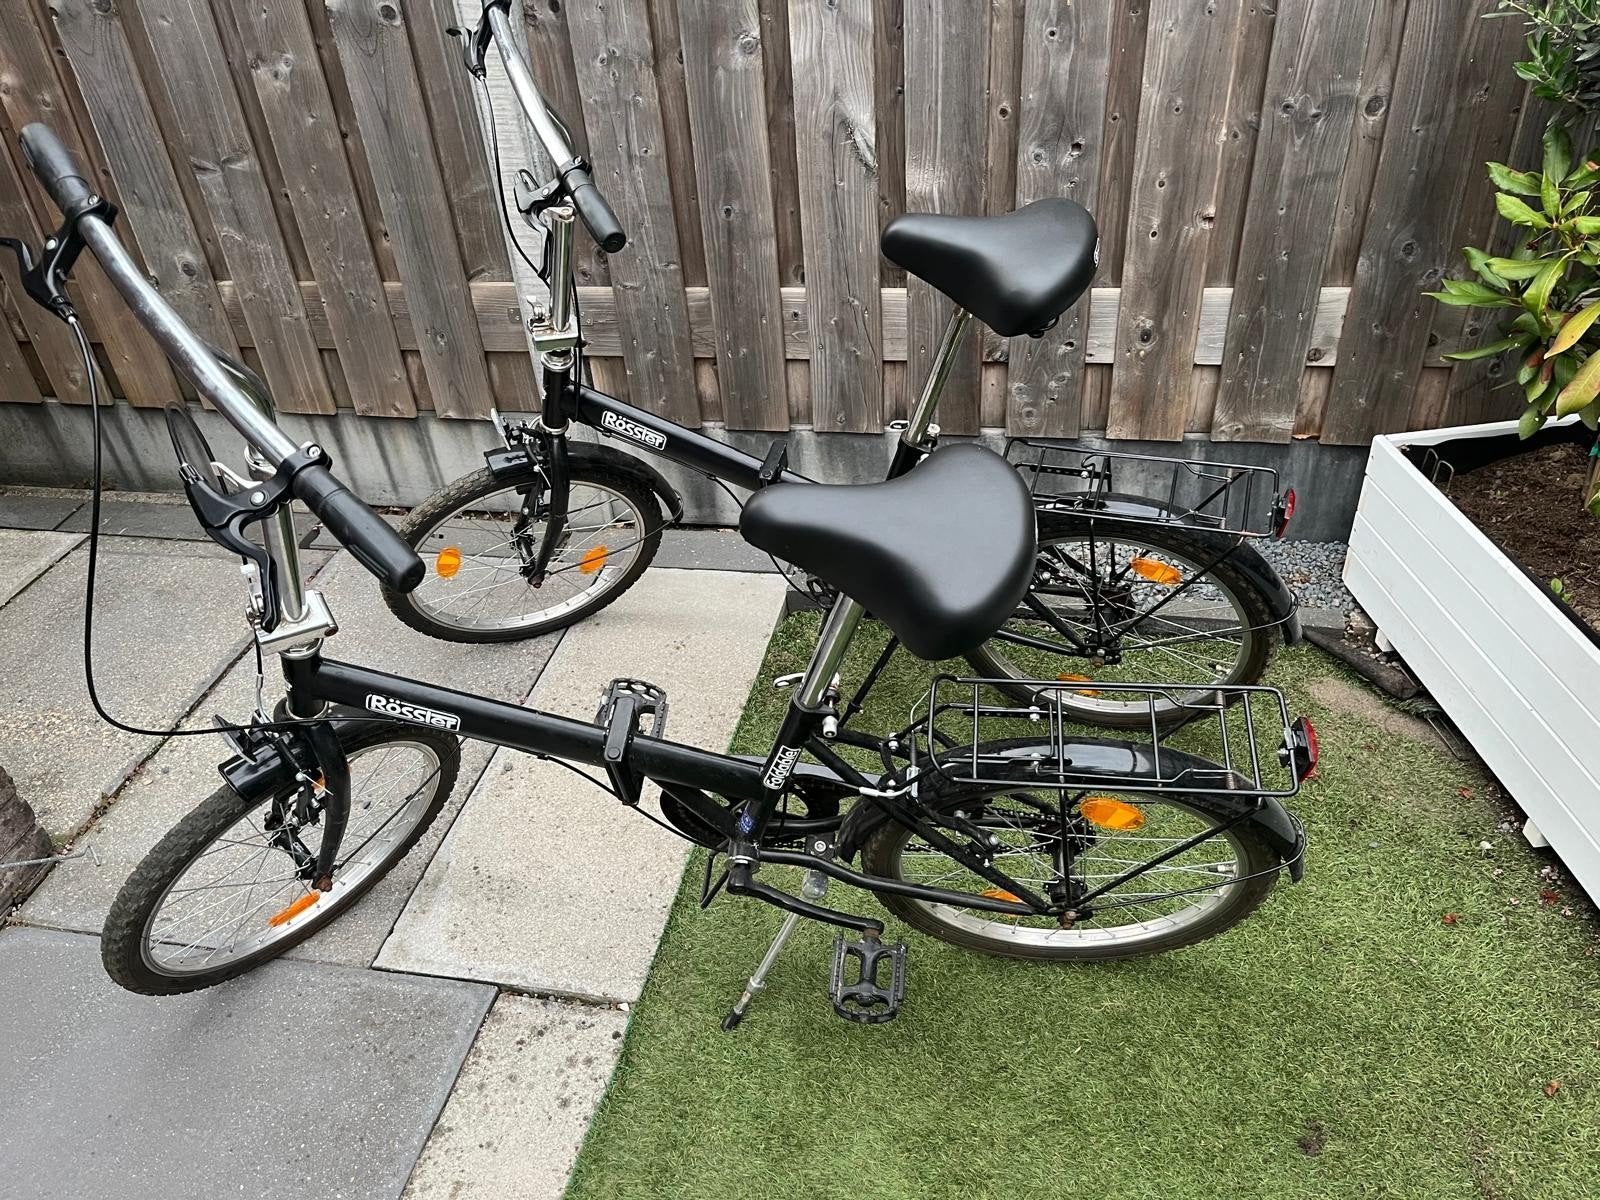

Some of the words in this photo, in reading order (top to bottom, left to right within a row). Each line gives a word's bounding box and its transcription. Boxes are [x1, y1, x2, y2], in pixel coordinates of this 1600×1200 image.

[604, 411, 664, 447] Rössler
[371, 694, 458, 729] Rössler
[766, 750, 798, 789] Foldable
